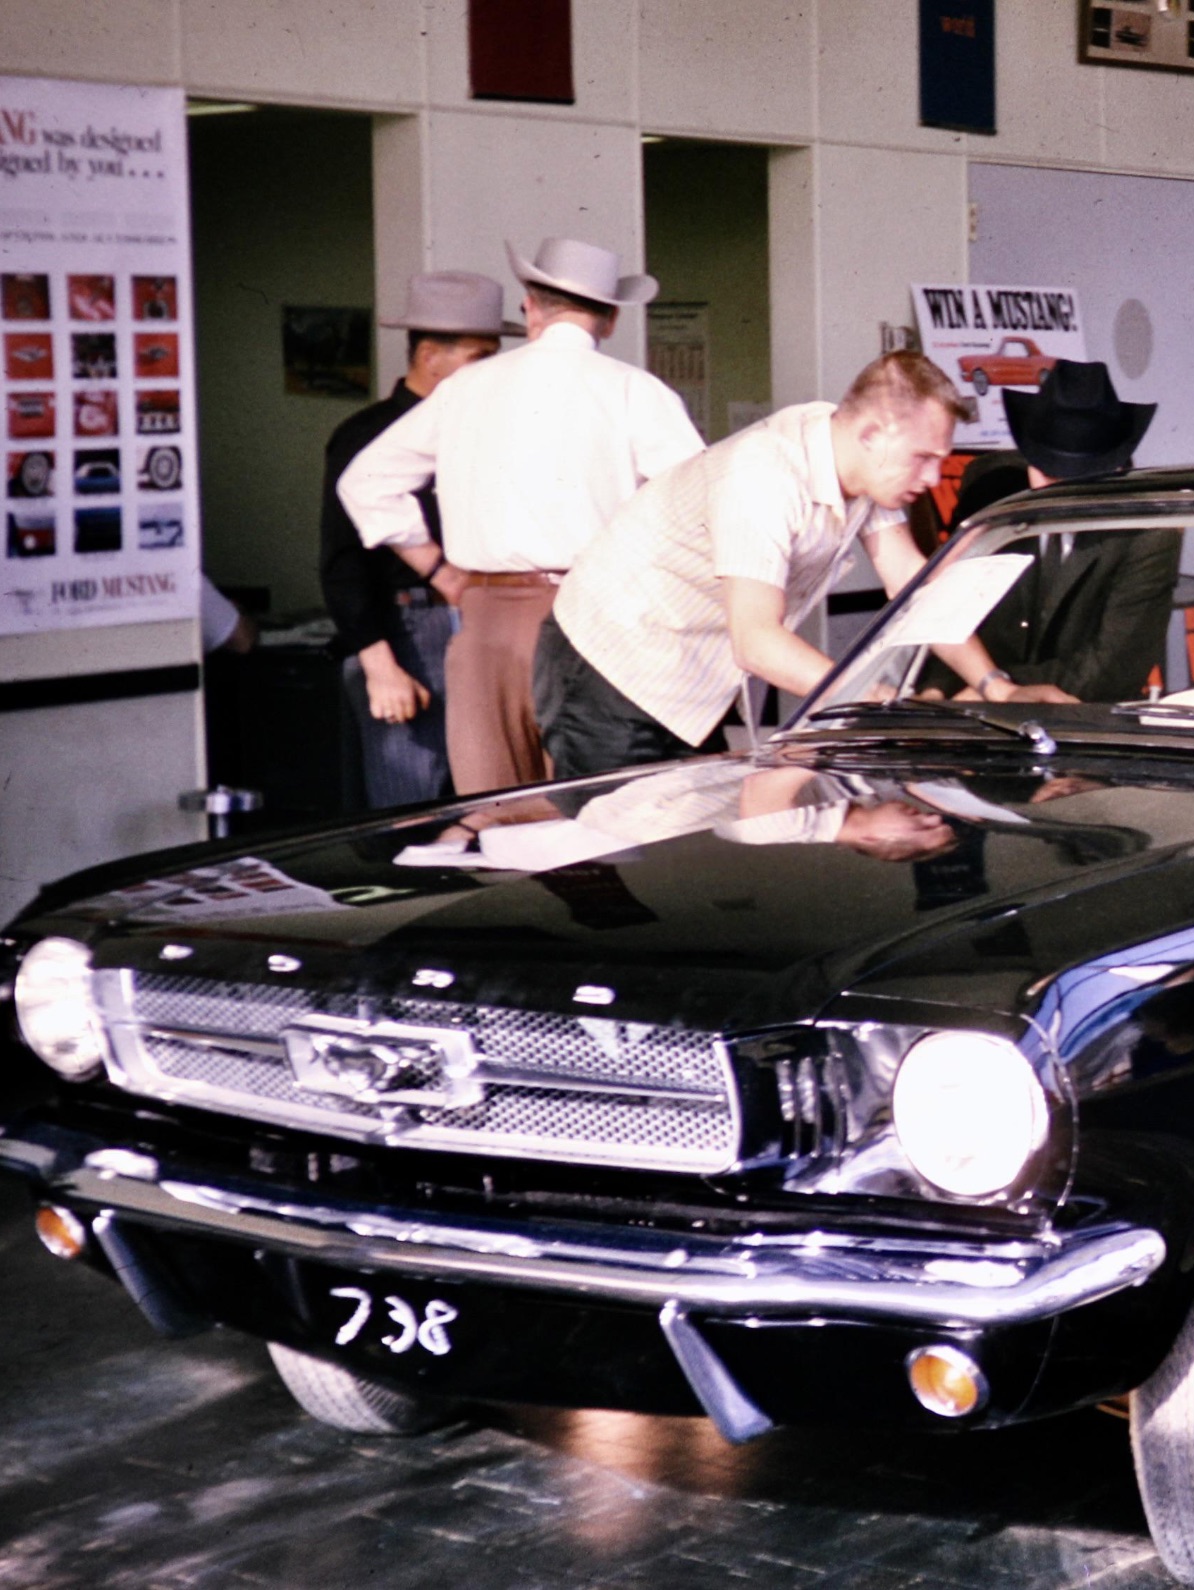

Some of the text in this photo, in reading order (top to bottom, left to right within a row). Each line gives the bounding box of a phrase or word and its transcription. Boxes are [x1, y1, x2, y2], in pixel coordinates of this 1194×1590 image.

[43, 129, 75, 147] was
[80, 126, 162, 156] designed
[57, 150, 80, 181] by
[923, 288, 1078, 332] WIN A MUSTANG!
[51, 572, 177, 603] FORD MUSTANG
[330, 1287, 458, 1355] 738
